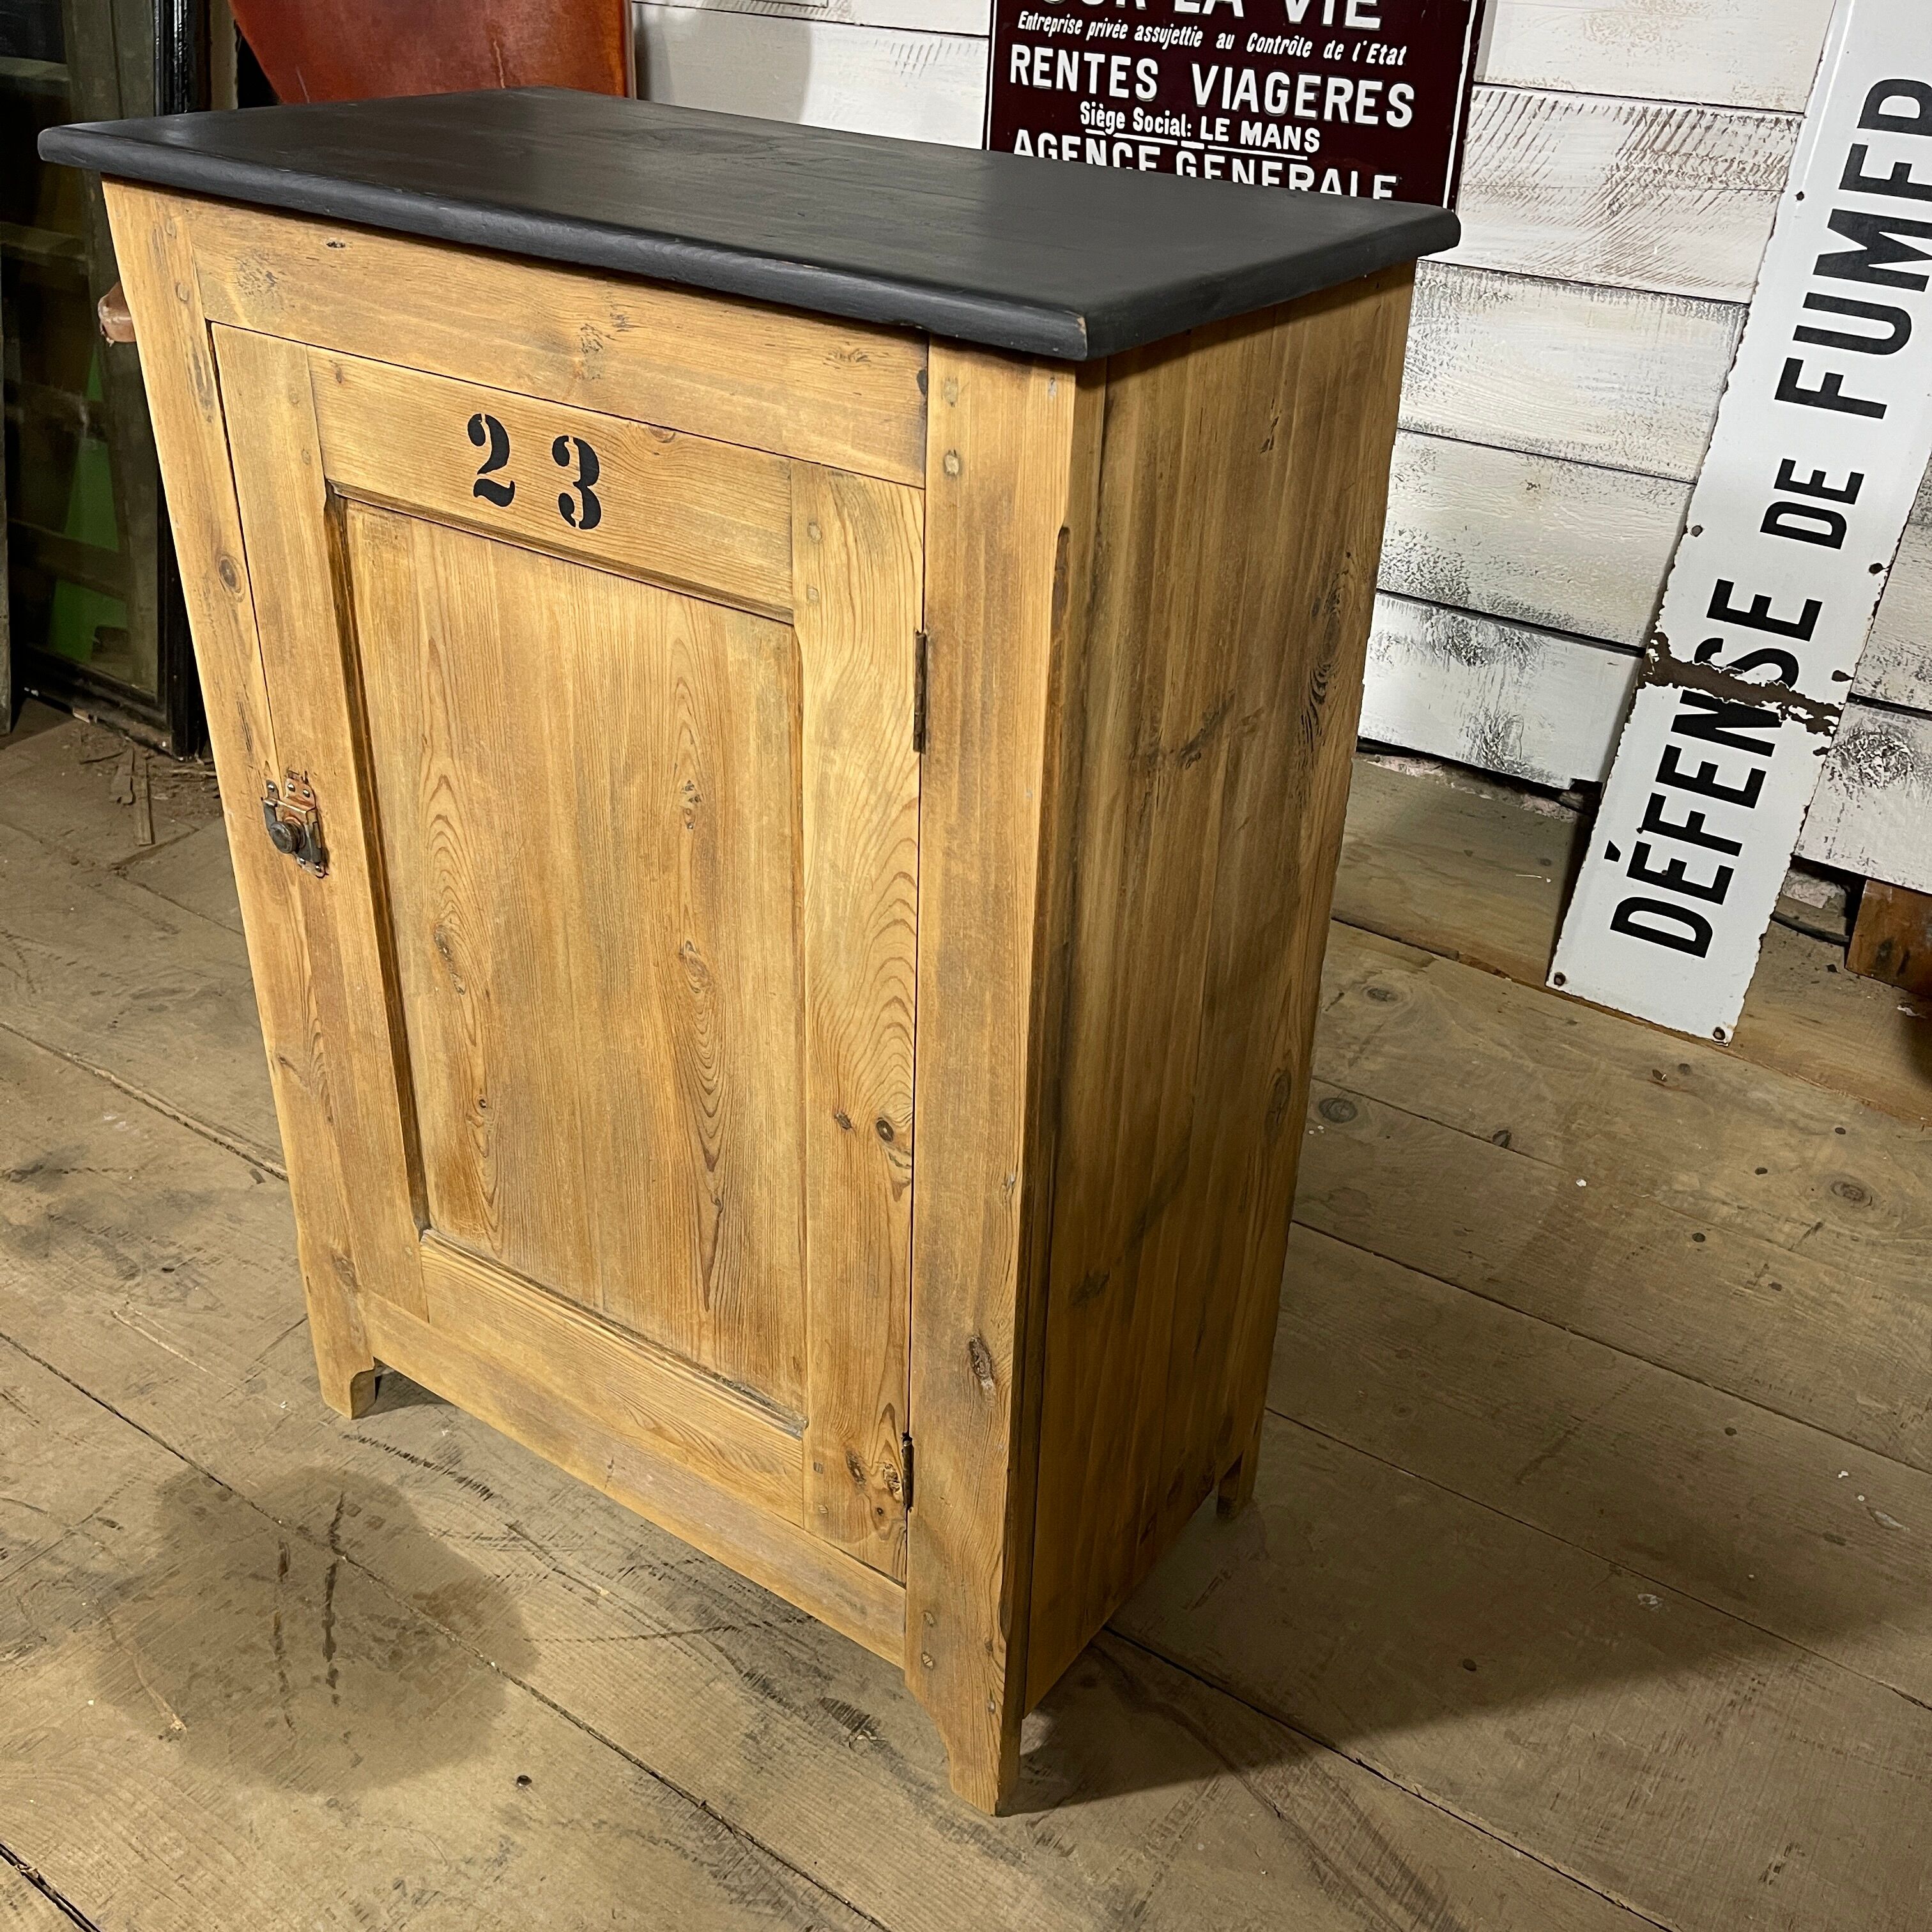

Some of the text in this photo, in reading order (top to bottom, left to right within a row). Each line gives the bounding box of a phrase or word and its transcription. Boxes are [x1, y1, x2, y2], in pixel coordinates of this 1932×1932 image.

[1018, 11, 1407, 65] Entreprise privée assujettie au Contrôle de l'Etat
[1009, 43, 1414, 128] RENTES VIAGERES
[1080, 101, 1321, 153] Siège Social: LE MANS
[1604, 579, 1823, 958] DÉFENSE
[1760, 458, 1864, 550] DE
